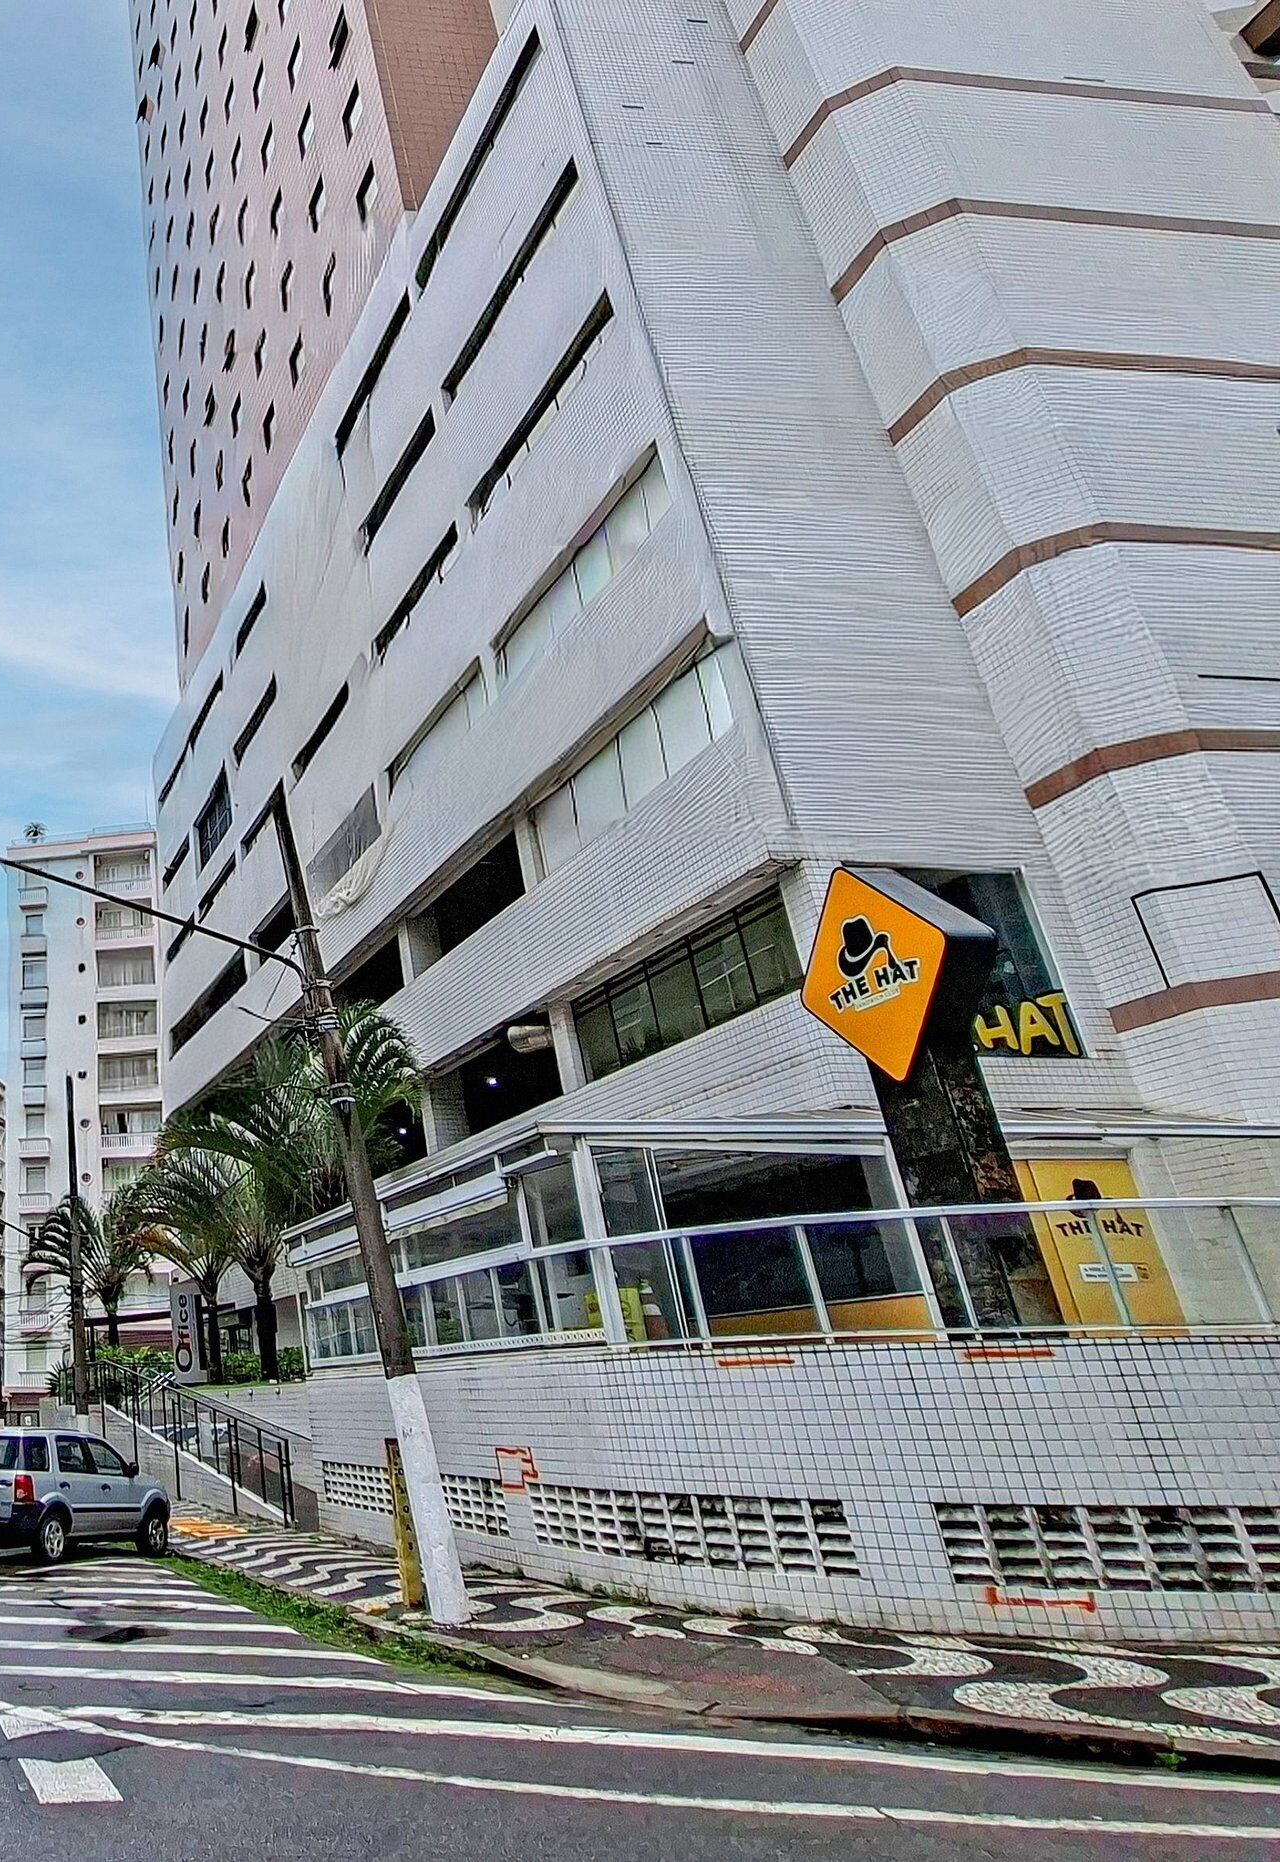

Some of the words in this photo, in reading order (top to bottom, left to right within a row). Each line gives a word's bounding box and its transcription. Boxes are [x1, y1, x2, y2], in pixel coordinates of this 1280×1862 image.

[830, 976, 870, 1011] THE
[874, 960, 918, 988] HAT
[974, 992, 1080, 1056] HAT
[1101, 1219, 1144, 1238] HAT
[175, 1294, 193, 1372] Office
